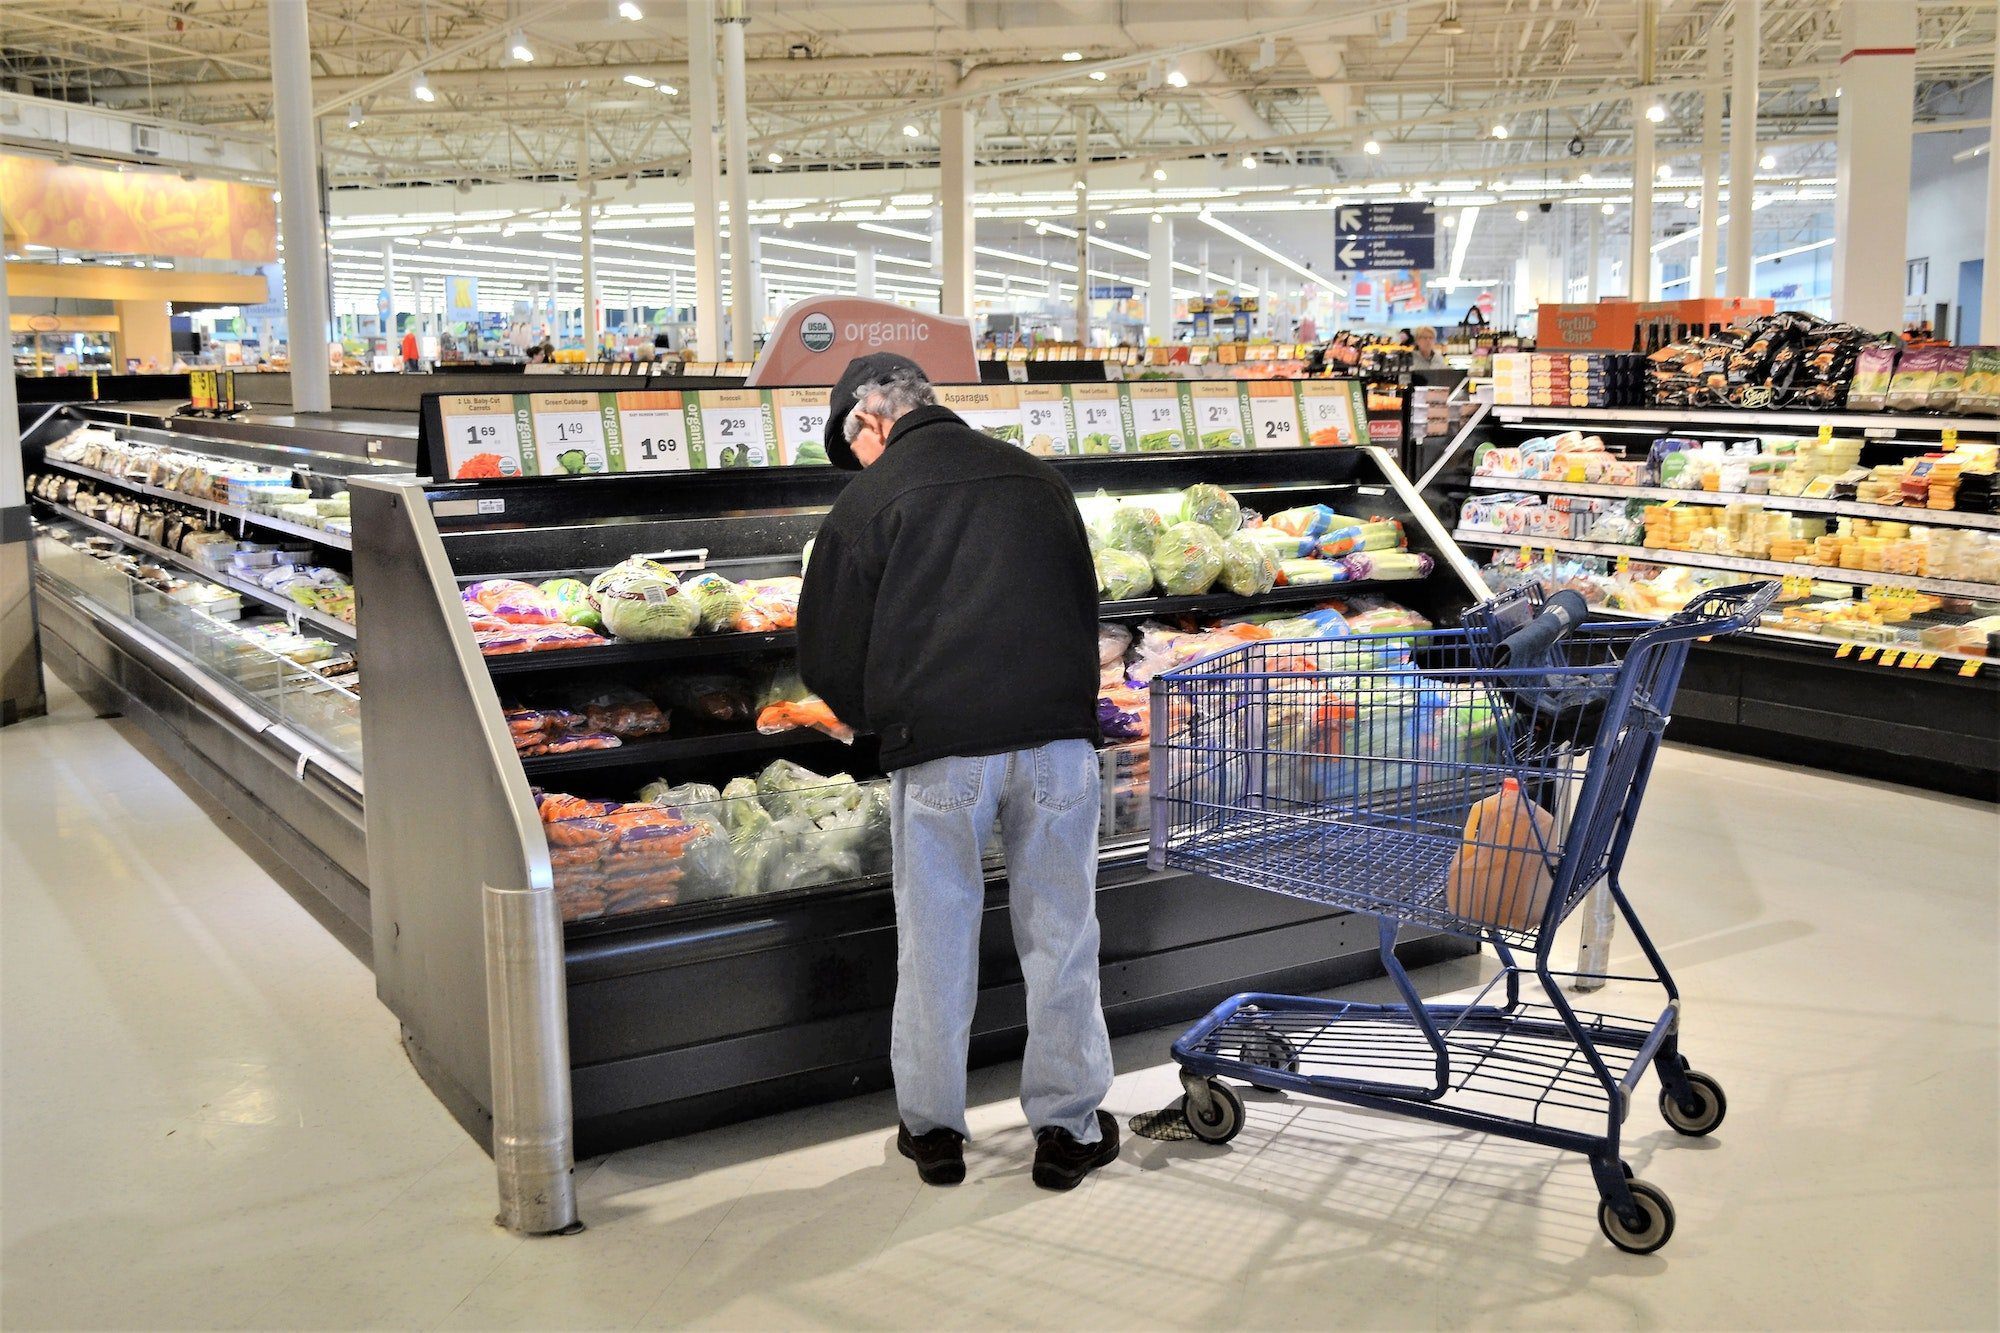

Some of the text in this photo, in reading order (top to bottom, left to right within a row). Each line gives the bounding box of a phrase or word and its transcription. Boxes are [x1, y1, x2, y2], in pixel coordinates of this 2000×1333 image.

[1373, 224, 1415, 232] electronics
[1373, 249, 1406, 258] furniture
[1373, 259, 1416, 267] automotive
[804, 334, 832, 342] ORGANIC
[807, 322, 828, 331] USDA
[844, 319, 929, 347] organic
[1556, 315, 1597, 332] Tortilla
[1562, 329, 1592, 345] Chips
[944, 393, 989, 404] Asparagus
[1181, 394, 1196, 436] organic
[1240, 394, 1255, 435] organic
[1352, 391, 1367, 431] organic
[603, 406, 622, 456] organic
[686, 403, 705, 452] organic
[761, 403, 777, 451] organic
[1063, 396, 1077, 440] organic
[1120, 395, 1135, 438] organic
[516, 409, 536, 460] organic
